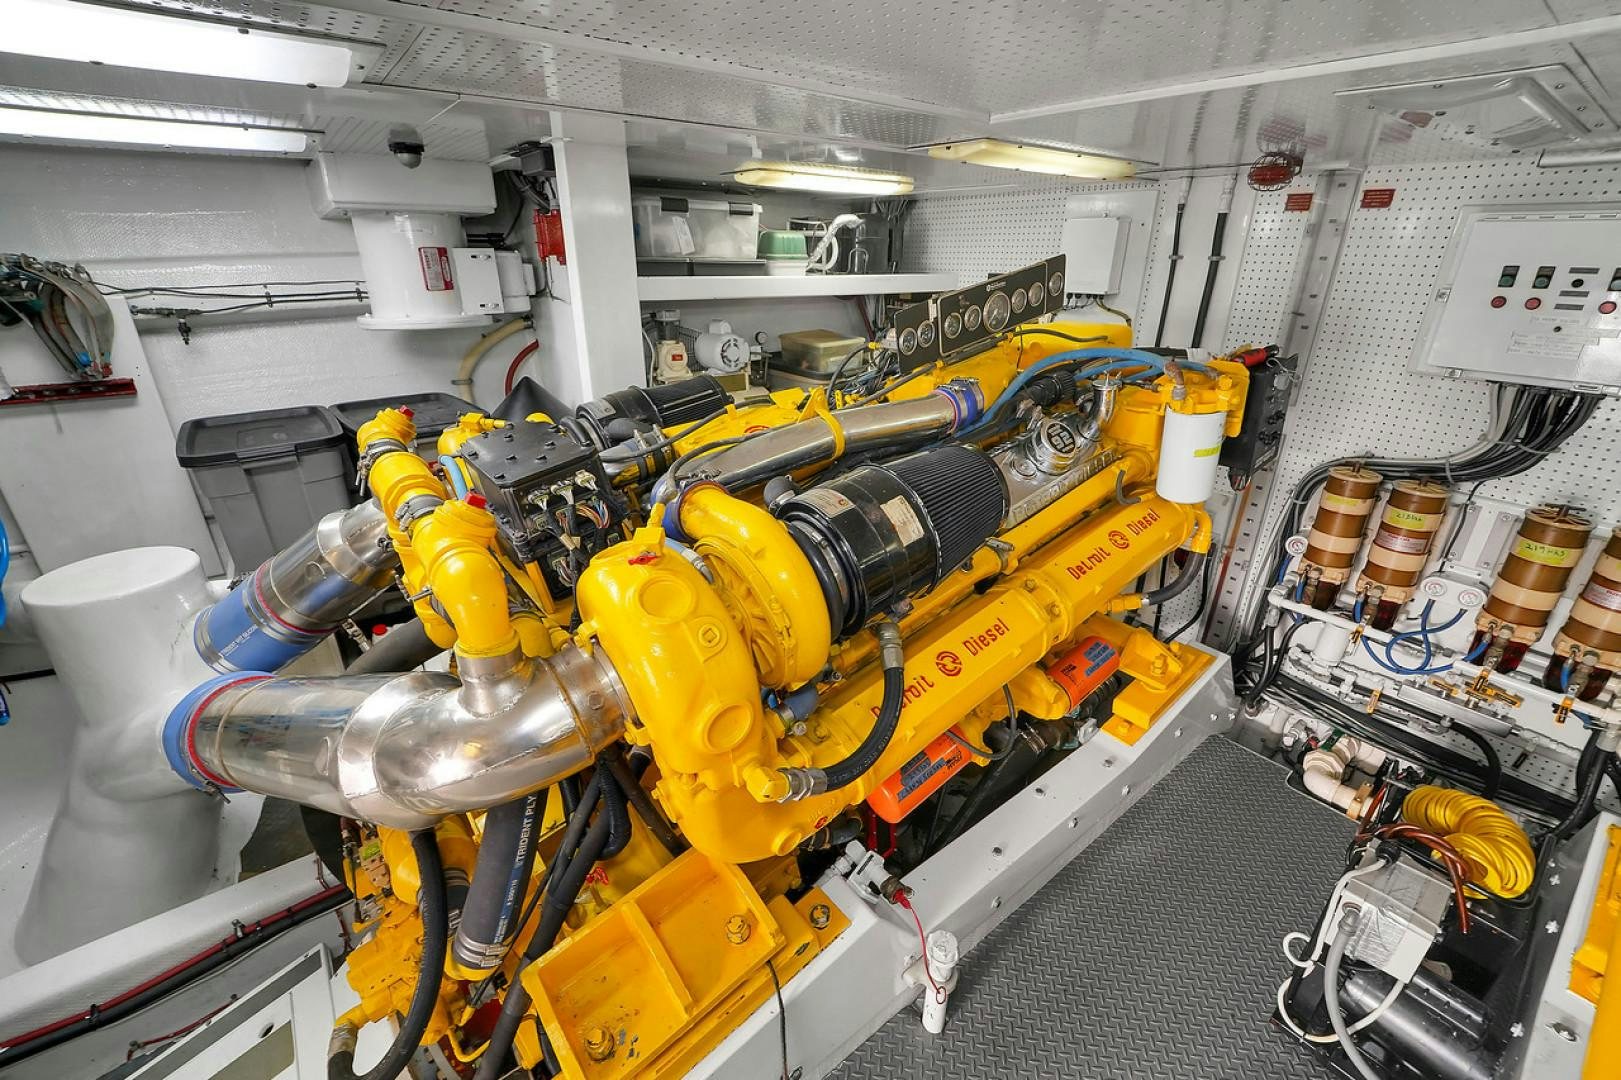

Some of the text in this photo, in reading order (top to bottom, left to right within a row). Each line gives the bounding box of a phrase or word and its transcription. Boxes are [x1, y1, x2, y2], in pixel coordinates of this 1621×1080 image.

[1066, 508, 1161, 580] Detroit Diesel
[962, 617, 1010, 657] Diesel
[516, 795, 537, 863] TRIDENT PLY
